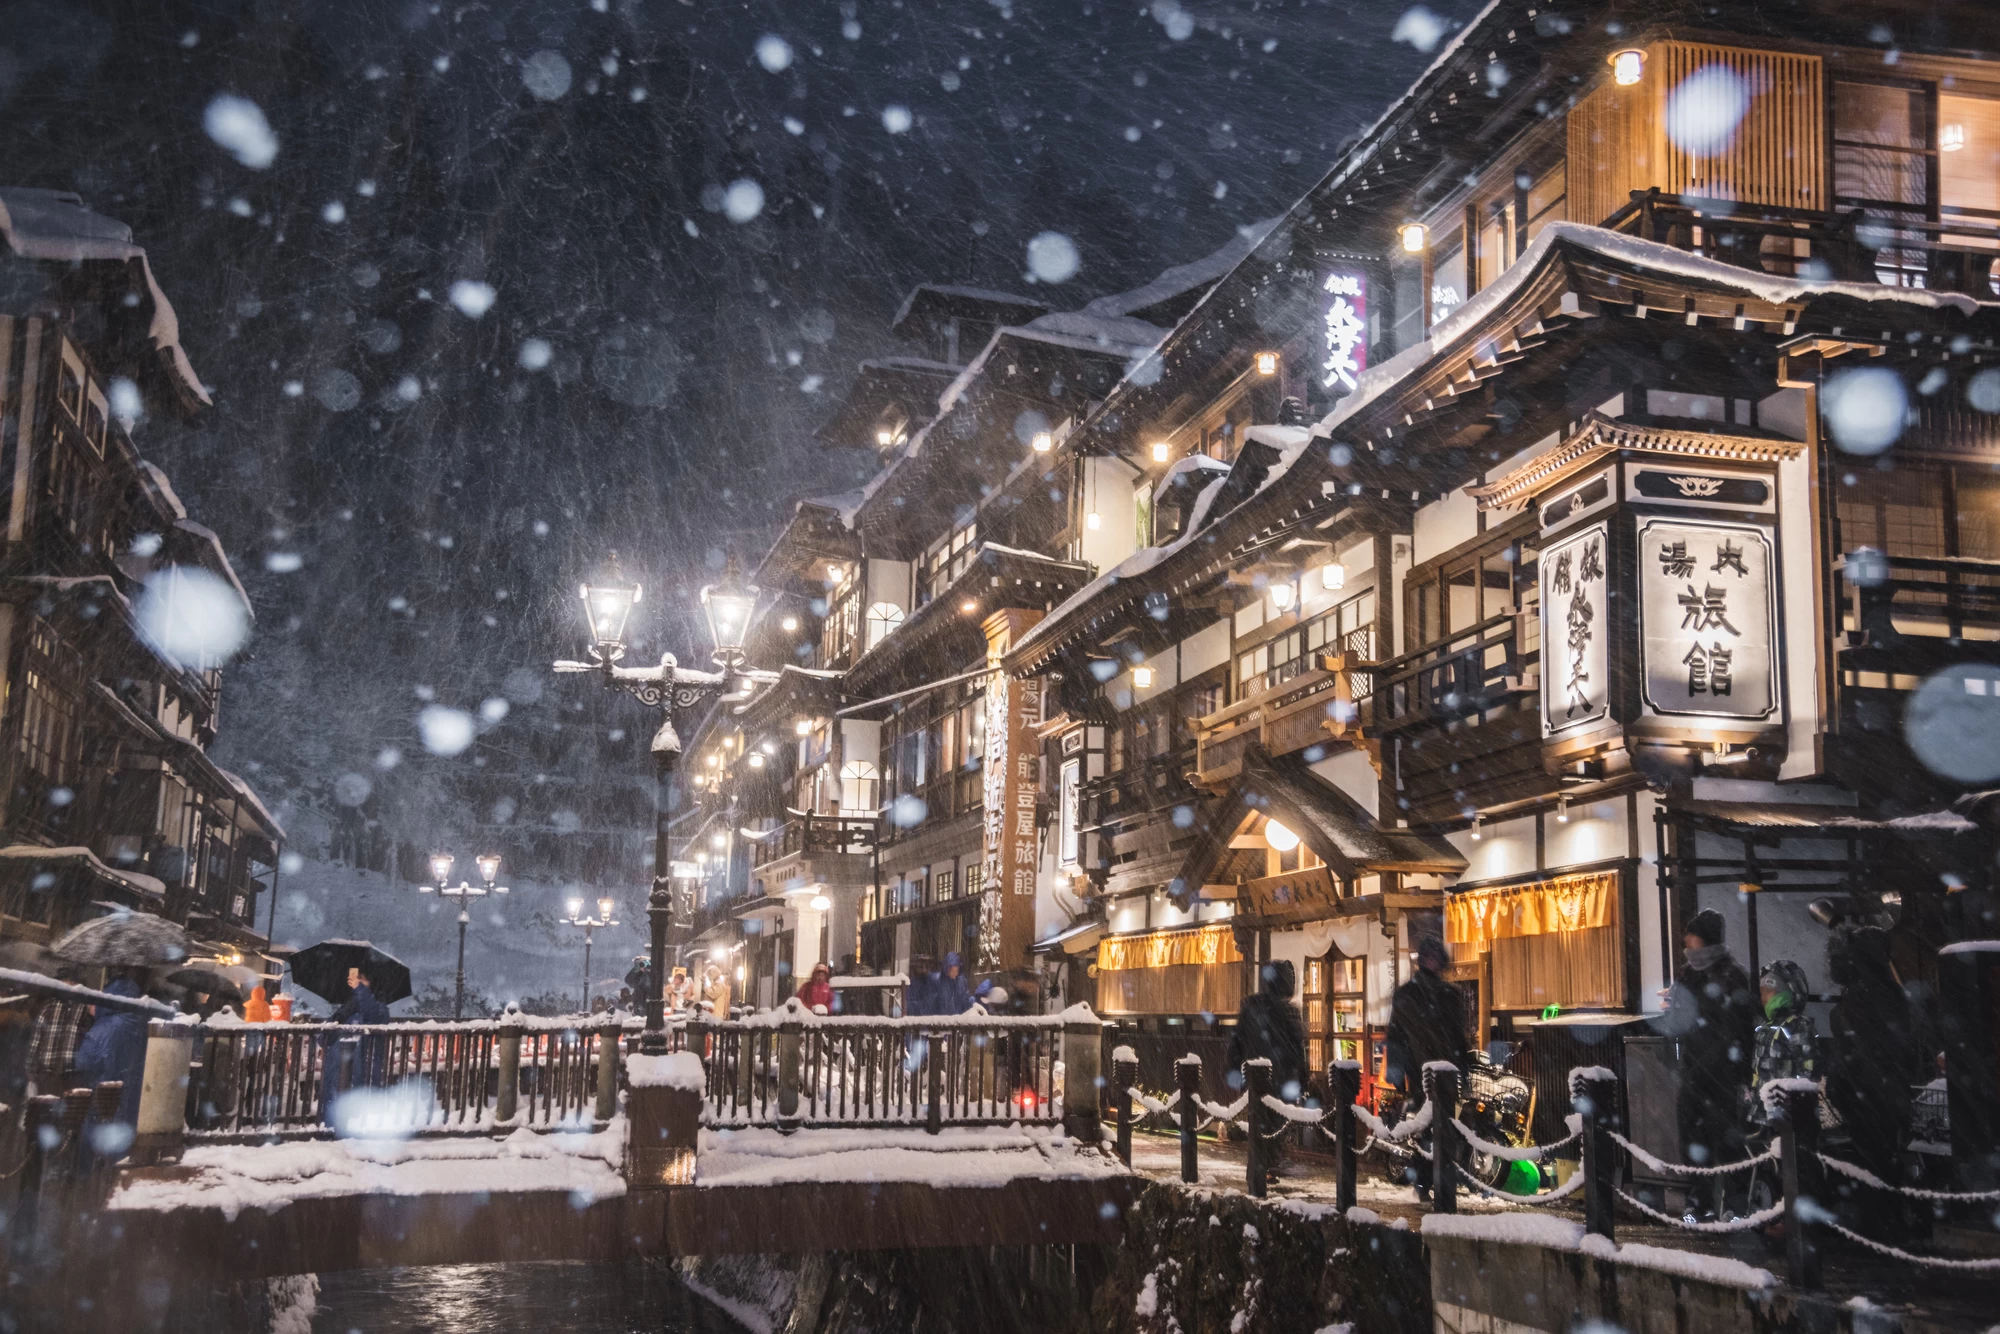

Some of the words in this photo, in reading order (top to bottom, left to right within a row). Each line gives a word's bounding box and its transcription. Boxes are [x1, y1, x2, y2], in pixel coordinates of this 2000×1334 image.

[1014, 753, 1037, 895] 能登屋旅館
